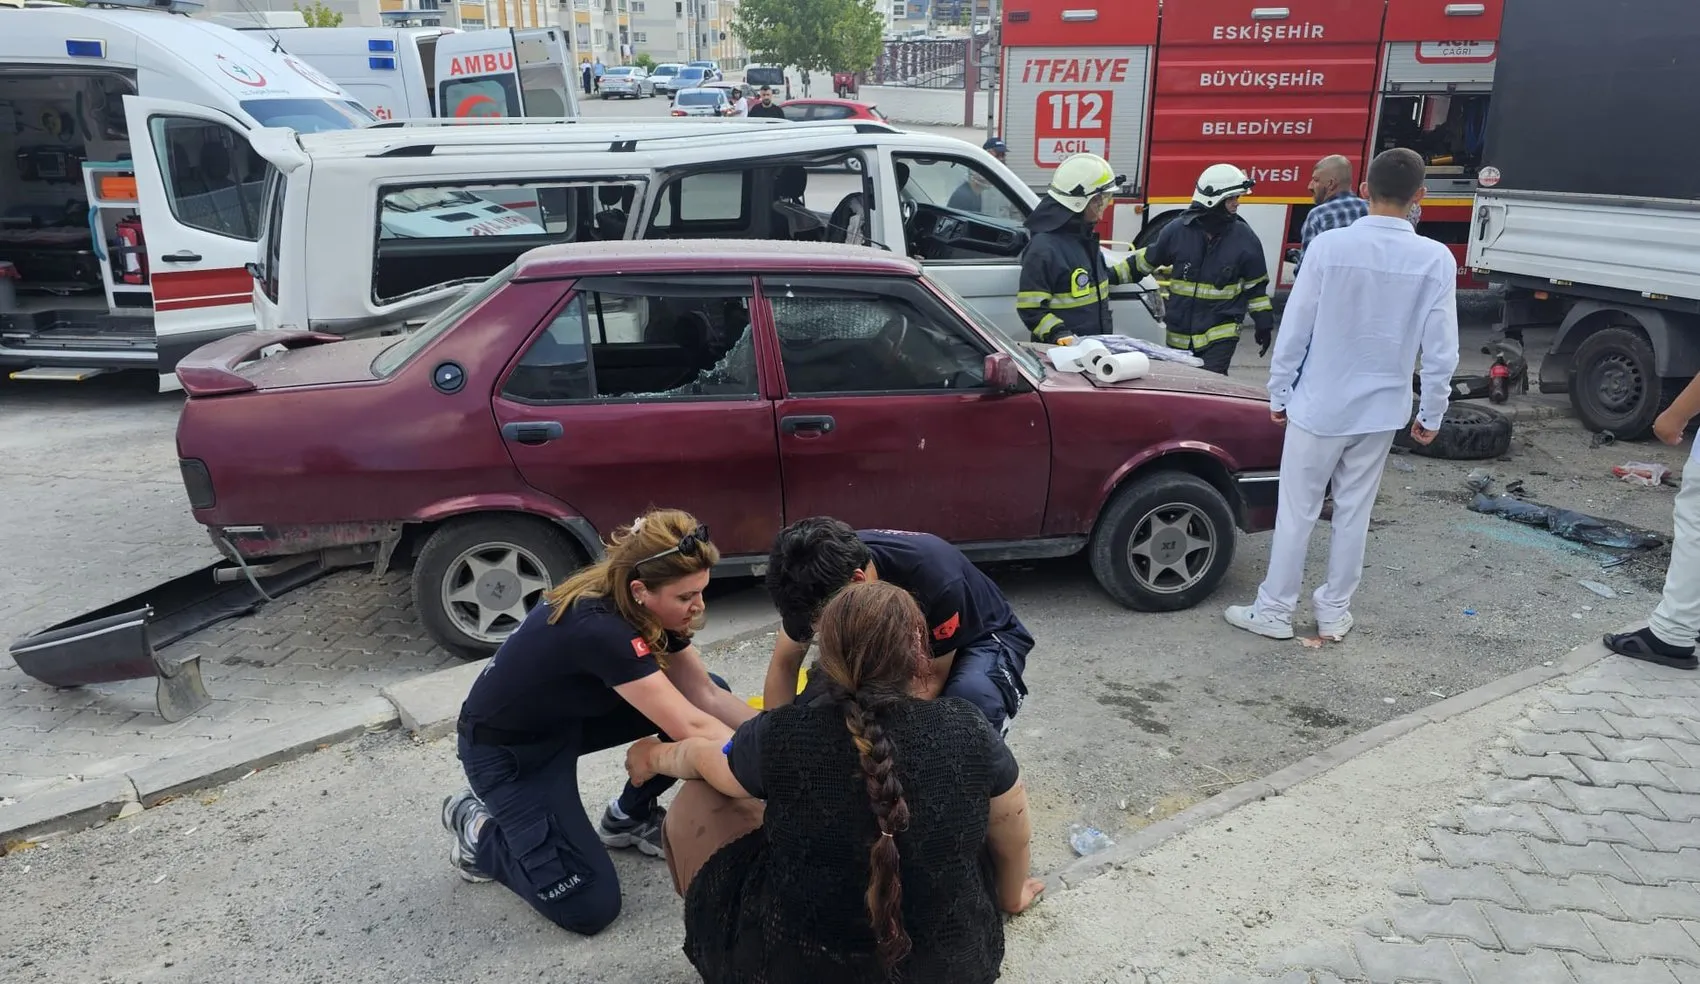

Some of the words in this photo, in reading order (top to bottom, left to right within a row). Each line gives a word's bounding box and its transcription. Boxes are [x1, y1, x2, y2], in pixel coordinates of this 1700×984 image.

[1212, 22, 1324, 43] ESKİŞEHİR
[450, 52, 513, 75] AMBU
[1021, 58, 1130, 83] İTFAİYE
[1199, 69, 1324, 89] BÜYÜKŞEHİR
[1048, 92, 1103, 129] 112
[1201, 118, 1313, 135] BELEDİYESİ
[1053, 140, 1090, 153] ACİL
